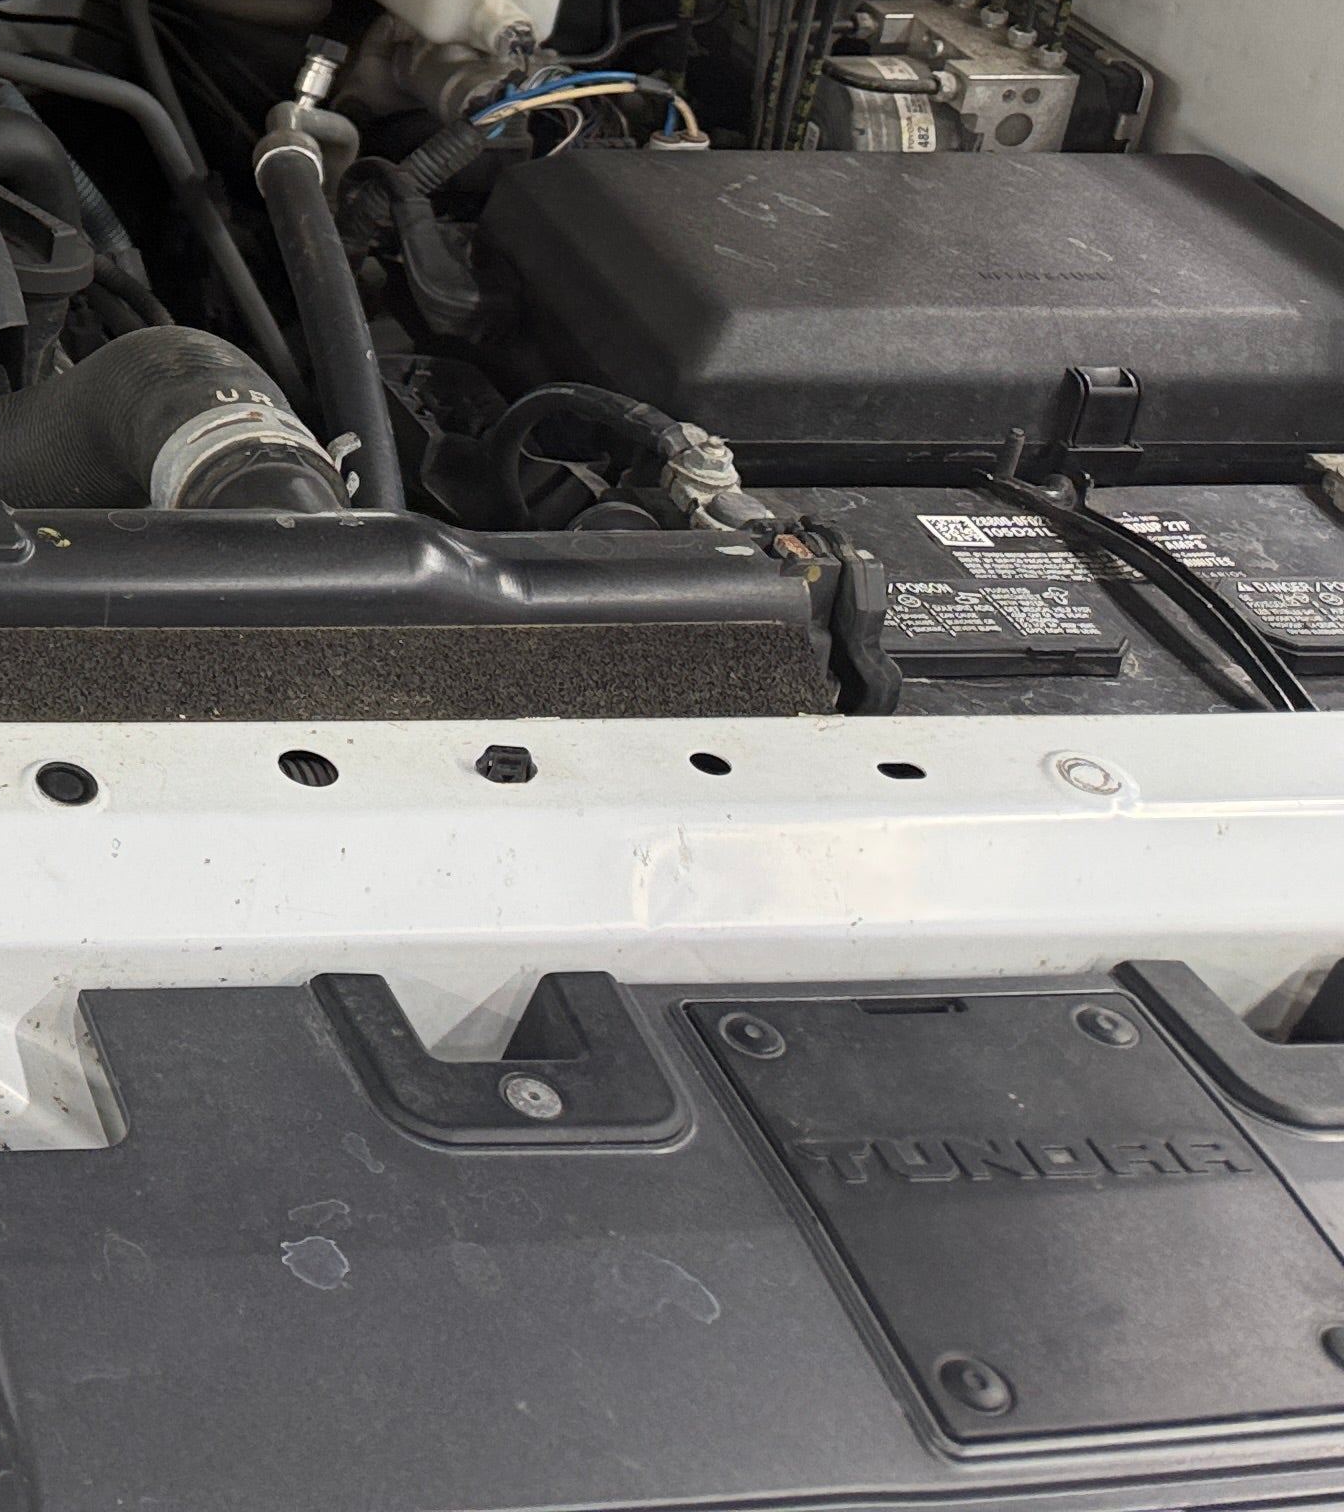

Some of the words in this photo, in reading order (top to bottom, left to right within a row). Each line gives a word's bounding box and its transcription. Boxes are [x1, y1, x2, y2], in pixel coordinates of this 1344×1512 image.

[895, 582, 954, 594] POISON
[1253, 581, 1315, 593] DANGER
[790, 1137, 1255, 1184] TUNDRA
